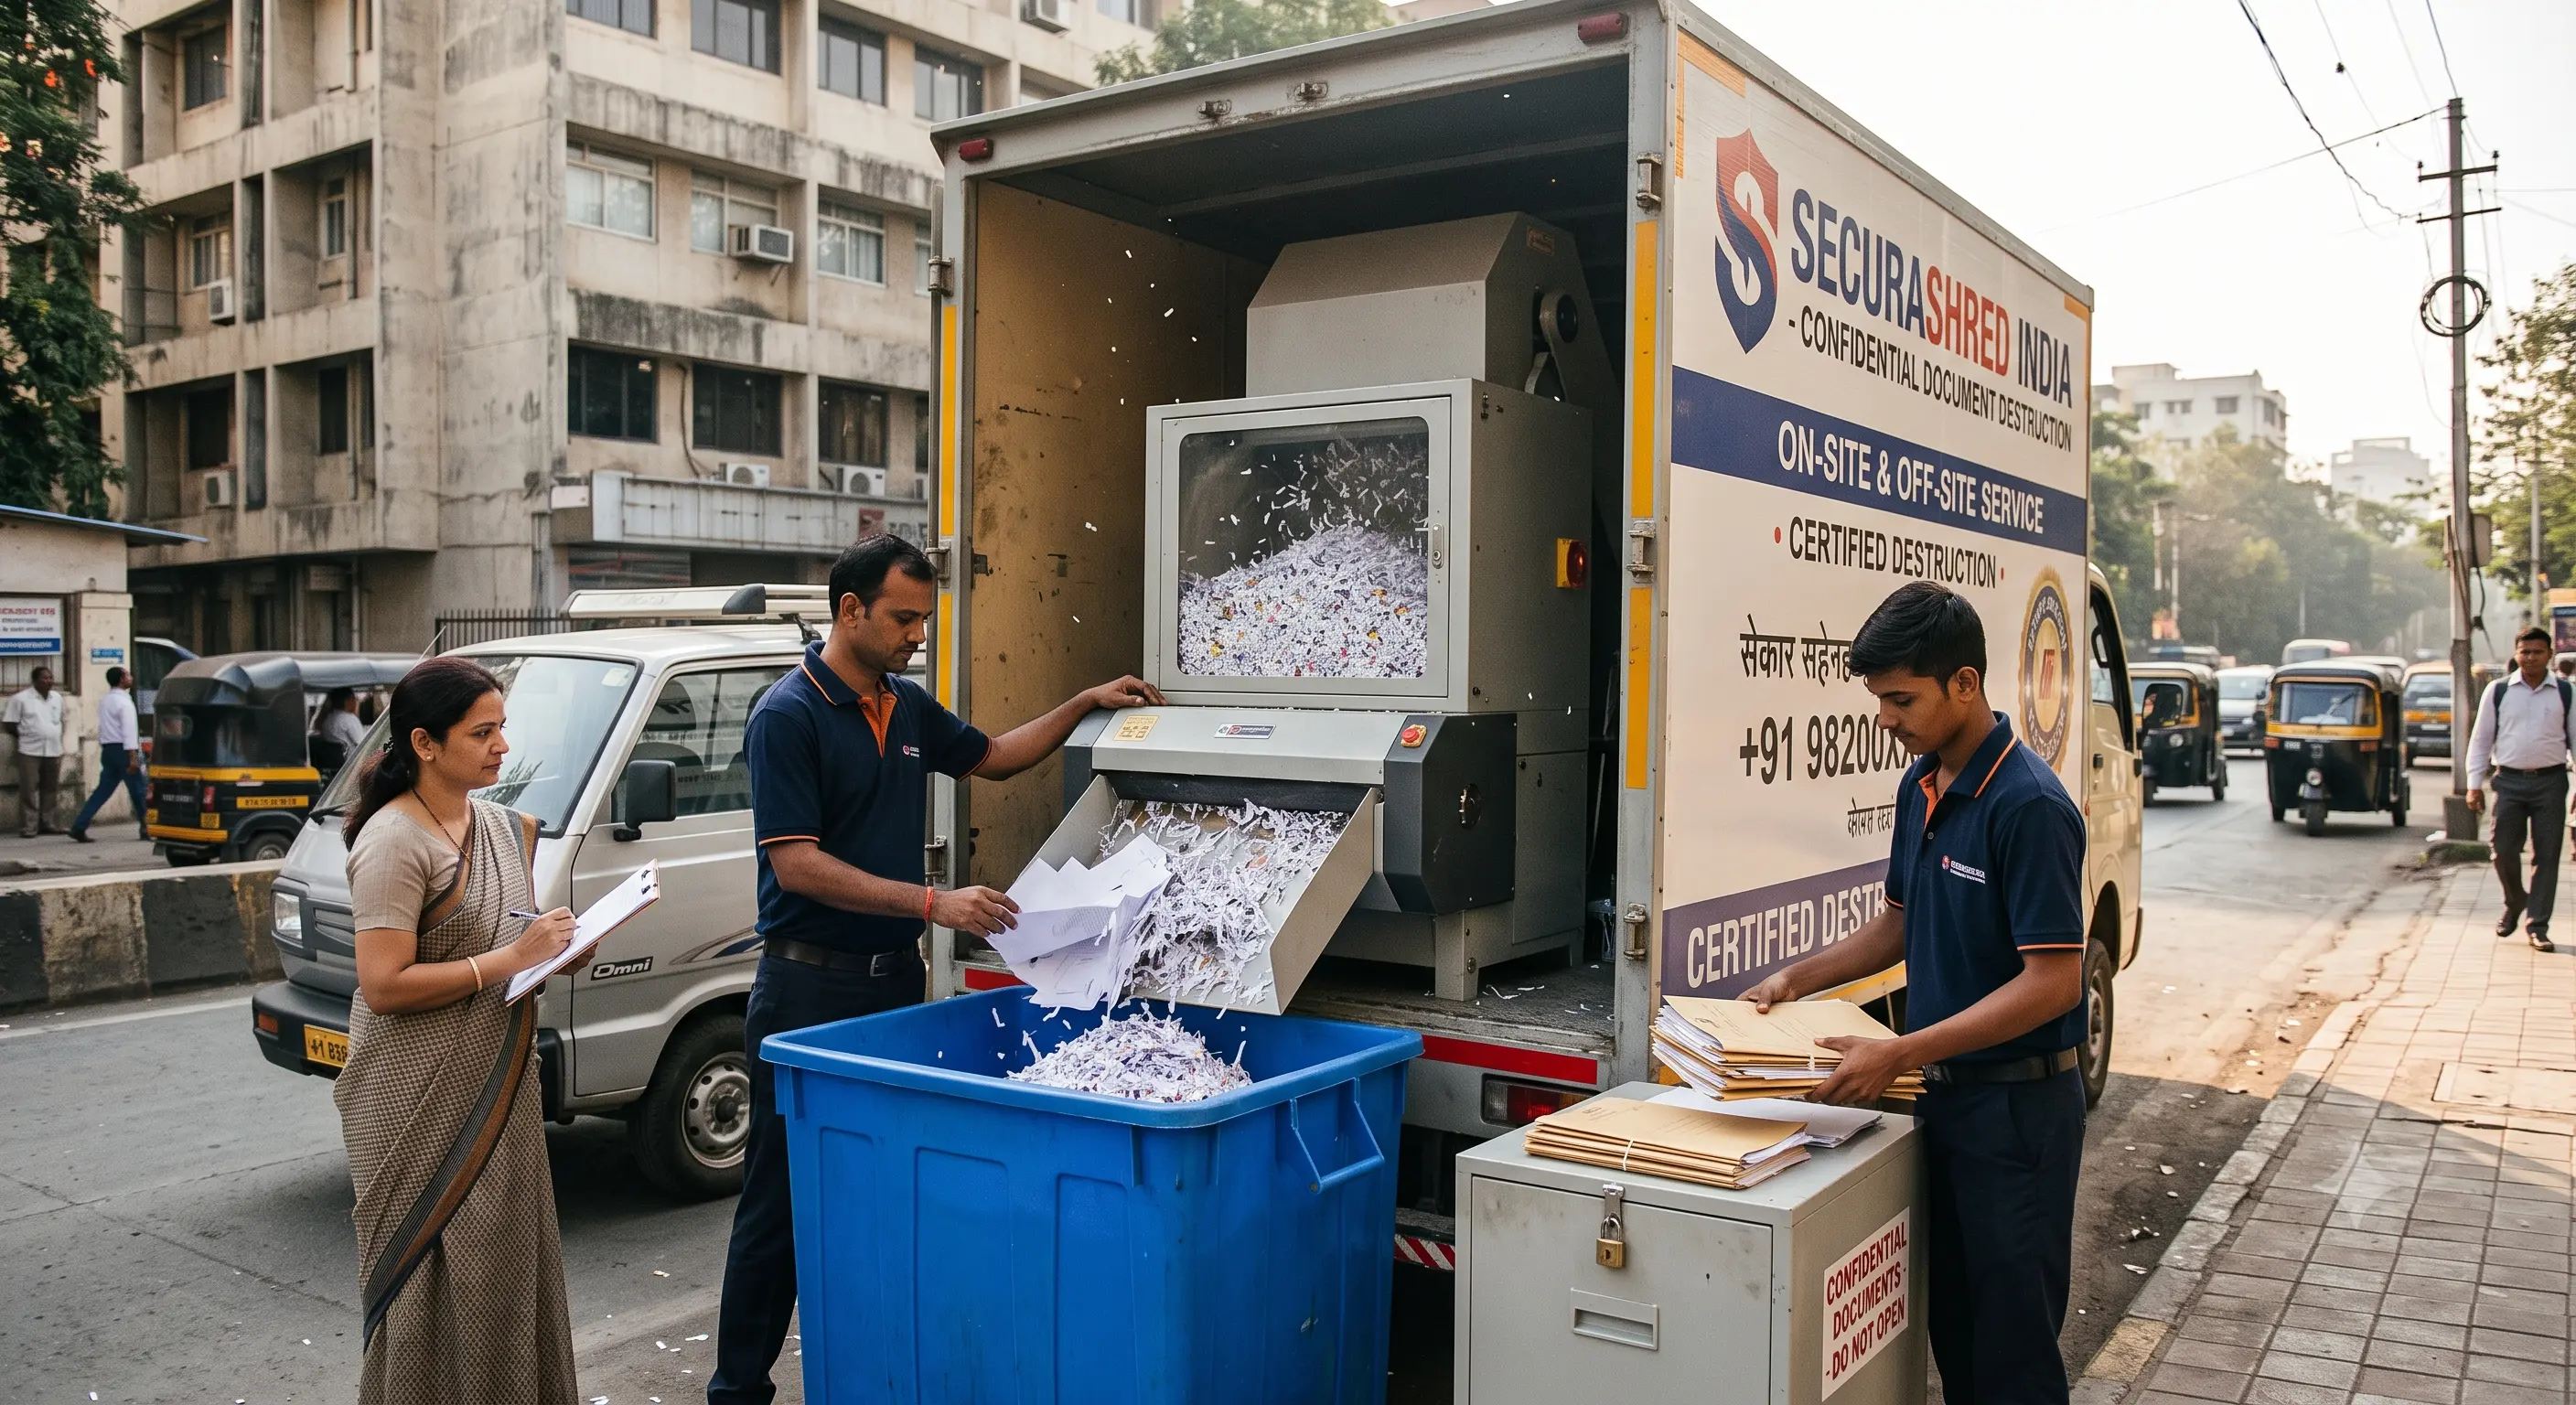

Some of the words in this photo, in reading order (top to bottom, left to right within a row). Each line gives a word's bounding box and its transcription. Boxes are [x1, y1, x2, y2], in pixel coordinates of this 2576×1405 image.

[1791, 188, 2010, 376] SECURASHRED
[2018, 317, 2072, 409] INDIA
[1801, 305, 1919, 392] CONFIDENTIAL
[1924, 359, 1996, 422] DOCUMENT
[1999, 394, 2072, 453] DESTRUCTION
[1778, 420, 1872, 490] ON-SITE
[1877, 450, 1891, 496] &
[1897, 456, 1976, 517] OFF-SITE
[1980, 480, 2044, 534] SERVICE
[1789, 516, 1887, 572] CERTIFIED
[1893, 536, 1996, 588] DESTRUCTION
[1740, 717, 1793, 785] +91
[594, 959, 650, 978] Omni
[1687, 899, 1815, 989] CERTIFIED
[1827, 1222, 1906, 1305] CONFIDENTIAL
[1833, 1260, 1900, 1341] DOCUMENTS
[1832, 1344, 1848, 1380] DO
[1852, 1321, 1873, 1364] NOT
[1877, 1294, 1905, 1340] OPEN
